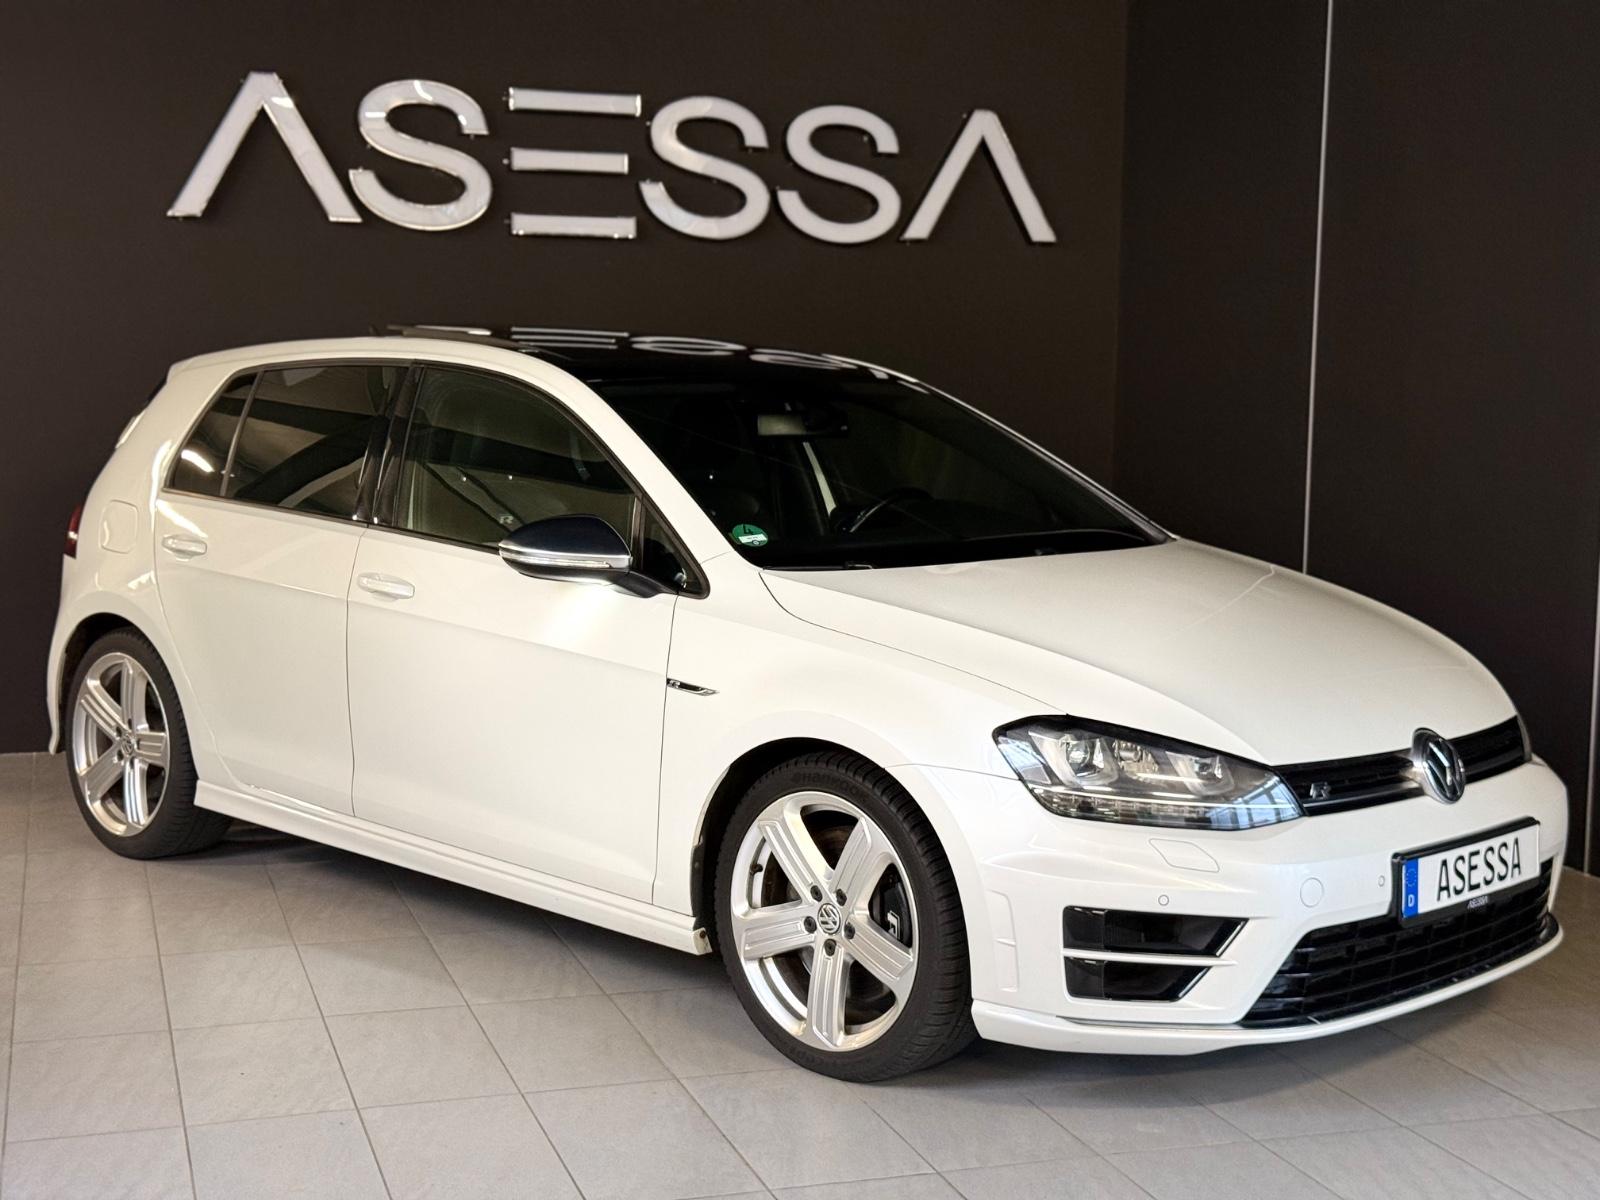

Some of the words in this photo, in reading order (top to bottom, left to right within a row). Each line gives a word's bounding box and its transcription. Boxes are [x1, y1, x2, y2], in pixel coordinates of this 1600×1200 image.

[166, 71, 1057, 244] ASESSA
[1309, 782, 1329, 799] R
[1437, 837, 1521, 901] ASESSA
[1408, 894, 1415, 907] D
